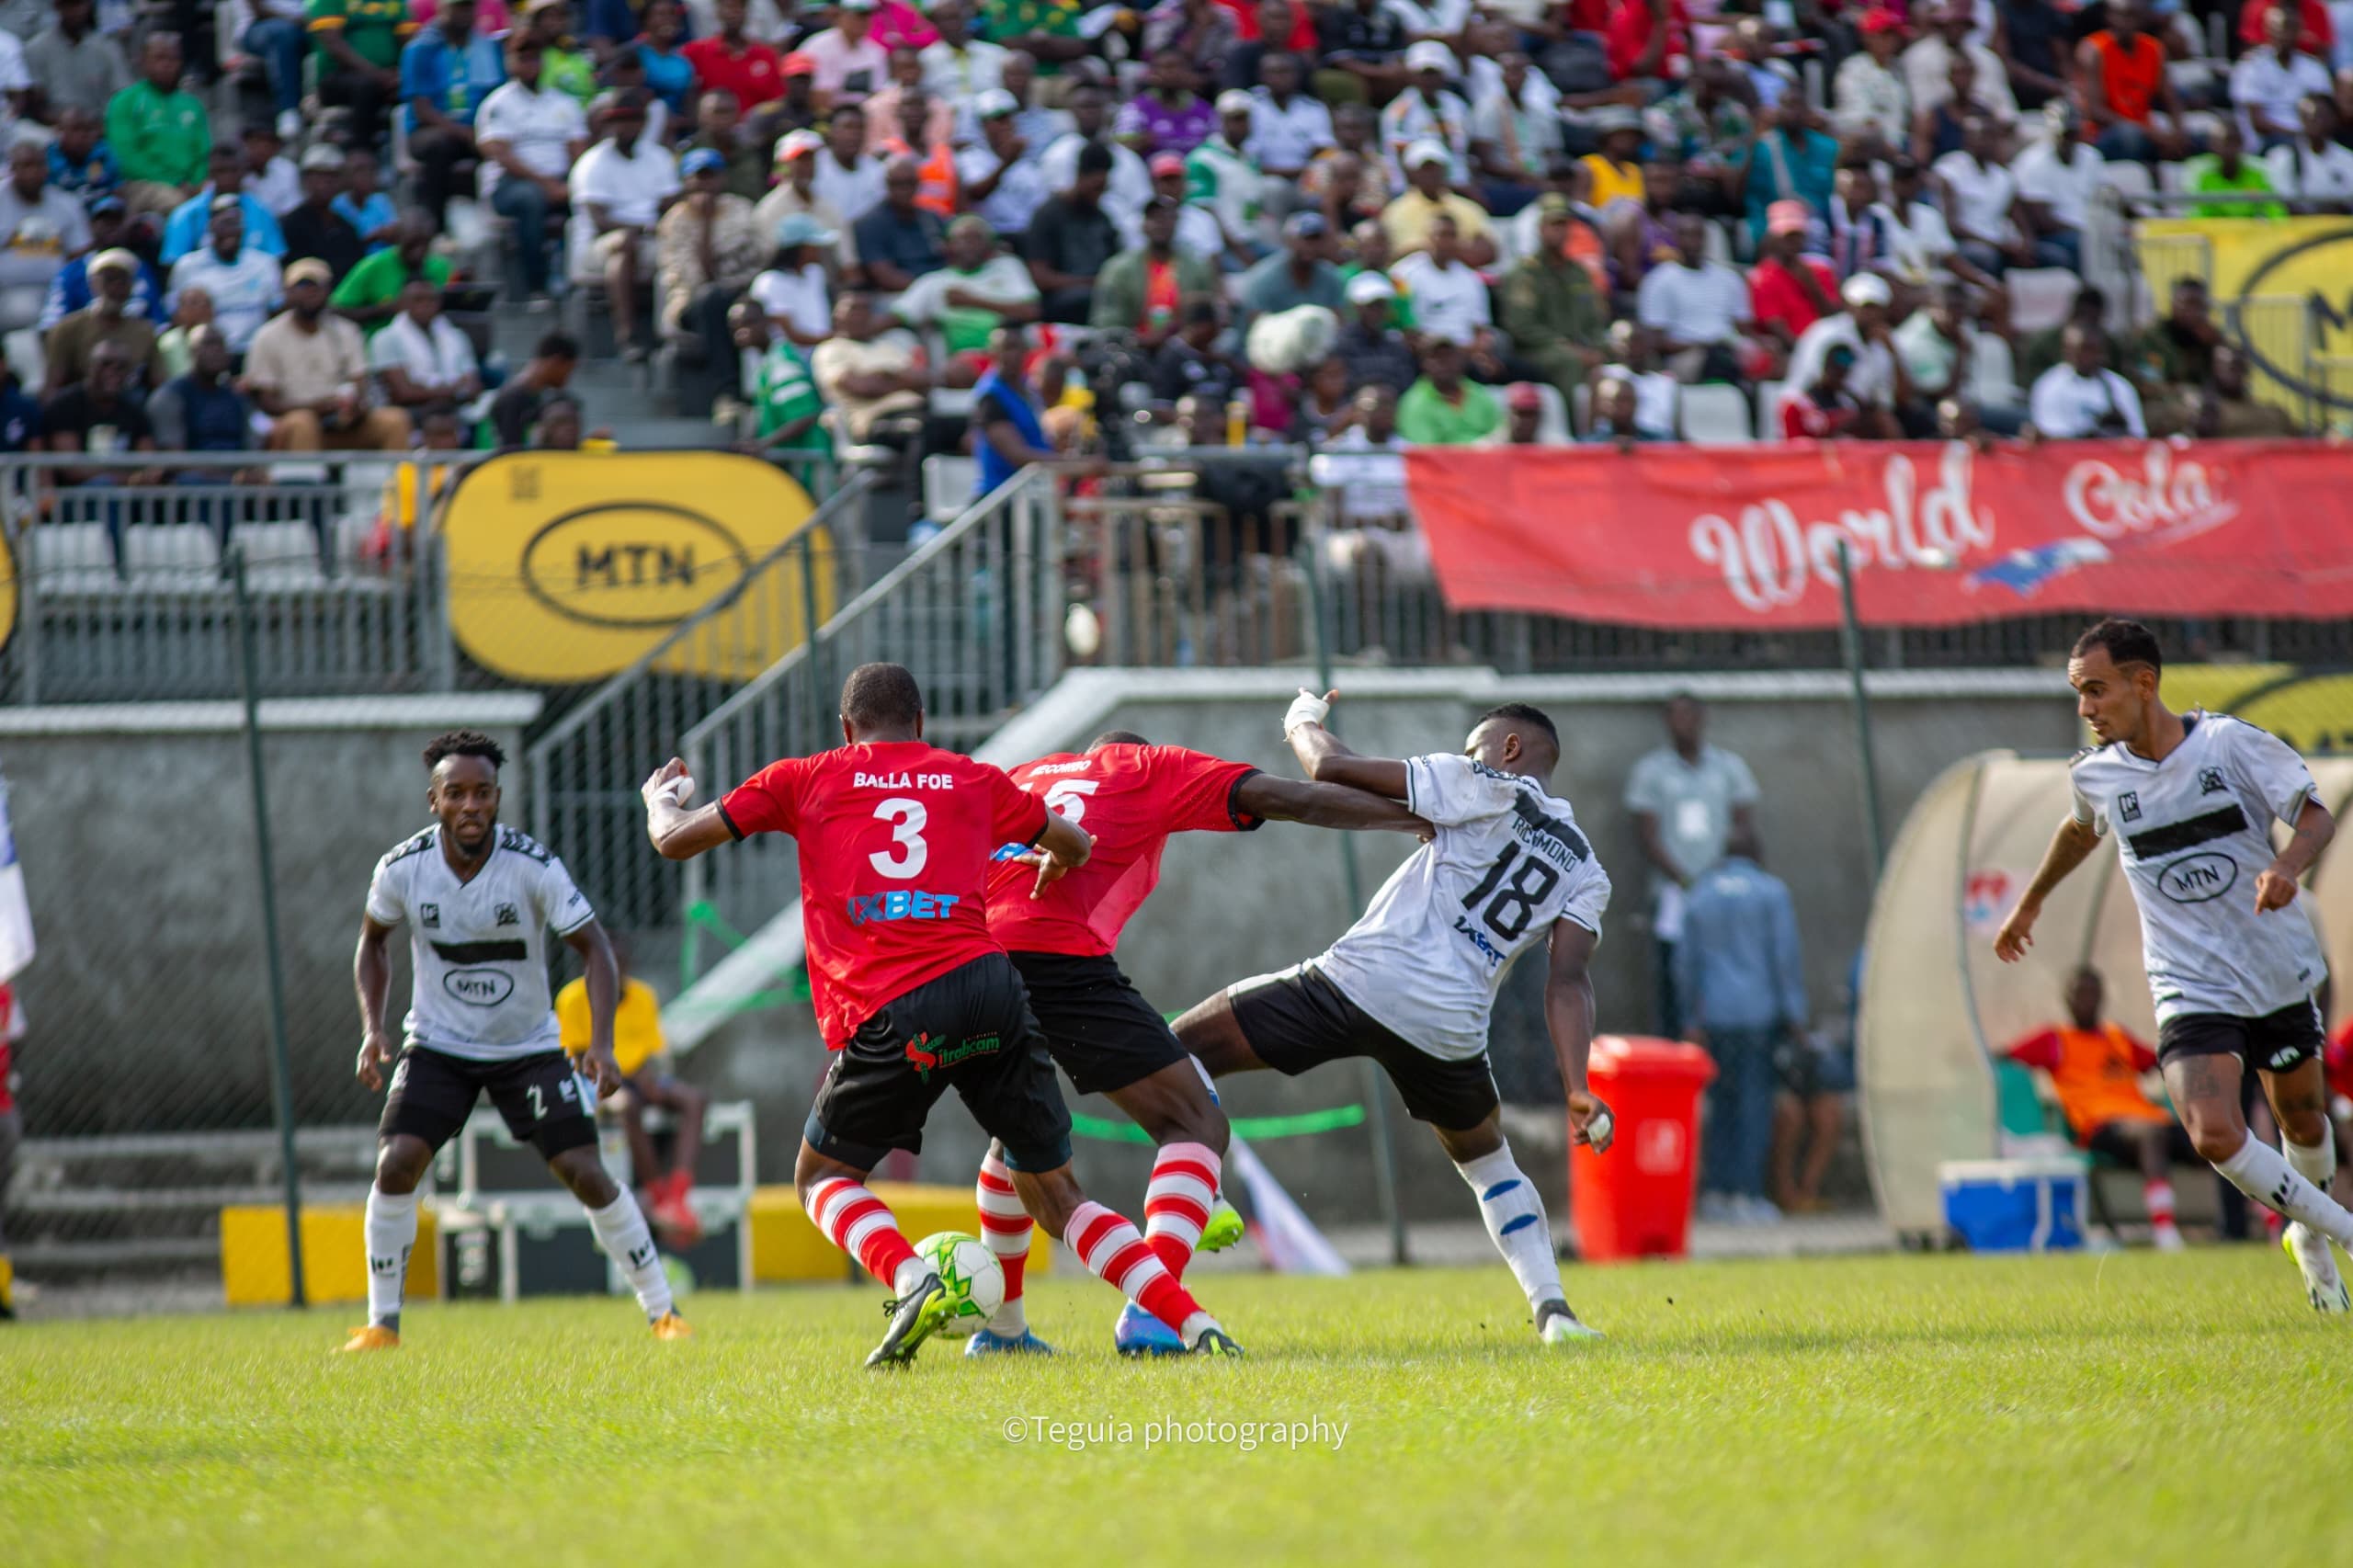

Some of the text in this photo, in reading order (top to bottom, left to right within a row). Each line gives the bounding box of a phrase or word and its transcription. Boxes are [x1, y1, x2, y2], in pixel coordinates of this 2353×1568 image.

[1689, 439, 2229, 611] World Cola
[575, 542, 696, 586] MTN
[853, 772, 954, 790] BALLA FOE
[869, 797, 927, 880] 3
[1461, 840, 1560, 941] 18
[2174, 865, 2221, 892] MTN
[456, 978, 496, 997] MTN
